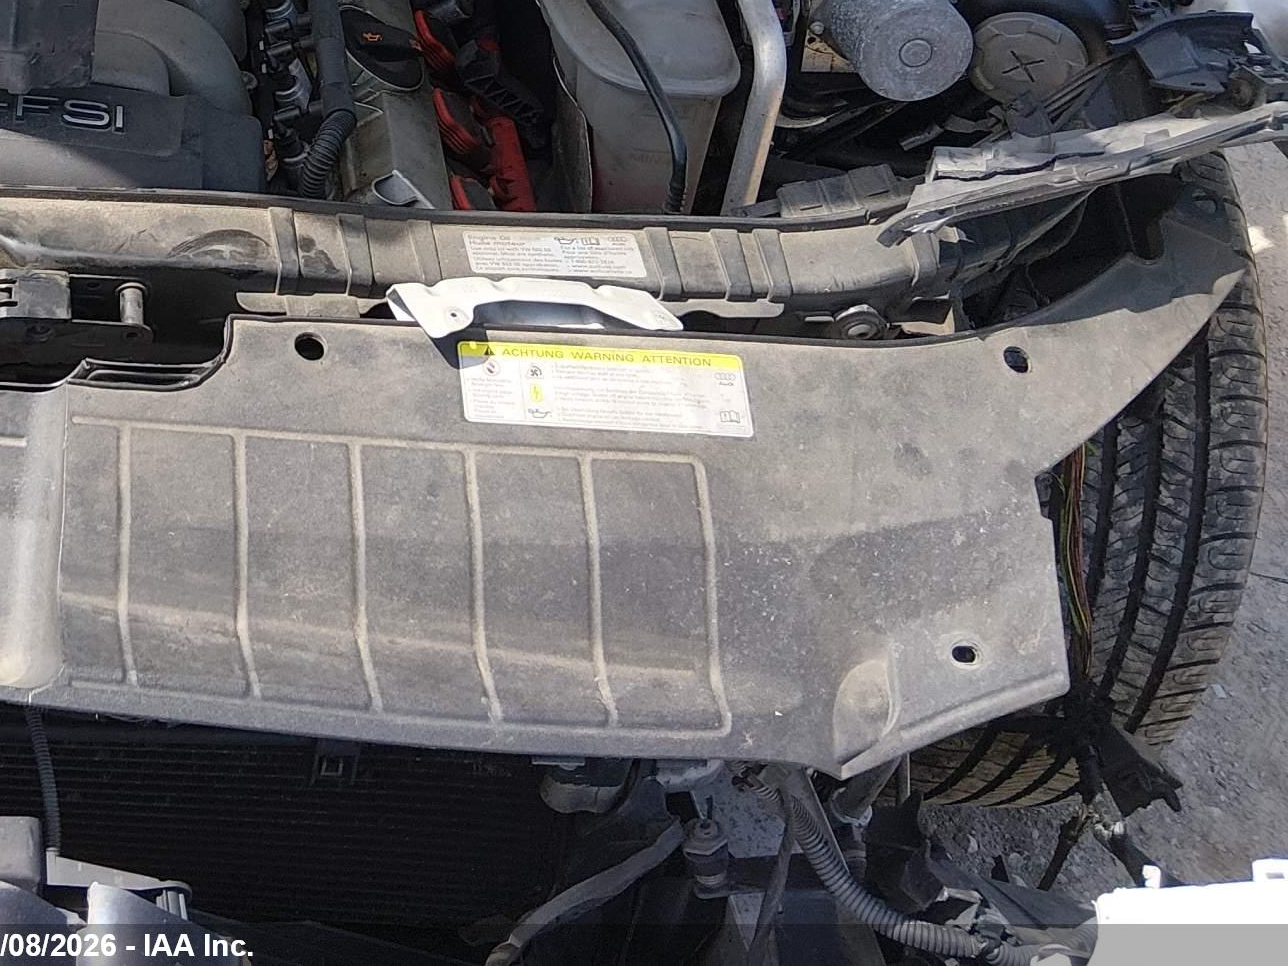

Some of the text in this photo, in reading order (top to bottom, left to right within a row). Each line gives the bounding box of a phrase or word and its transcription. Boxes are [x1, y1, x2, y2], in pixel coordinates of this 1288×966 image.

[502, 347, 712, 367] ACHTUNG WARNING ATTENTION
